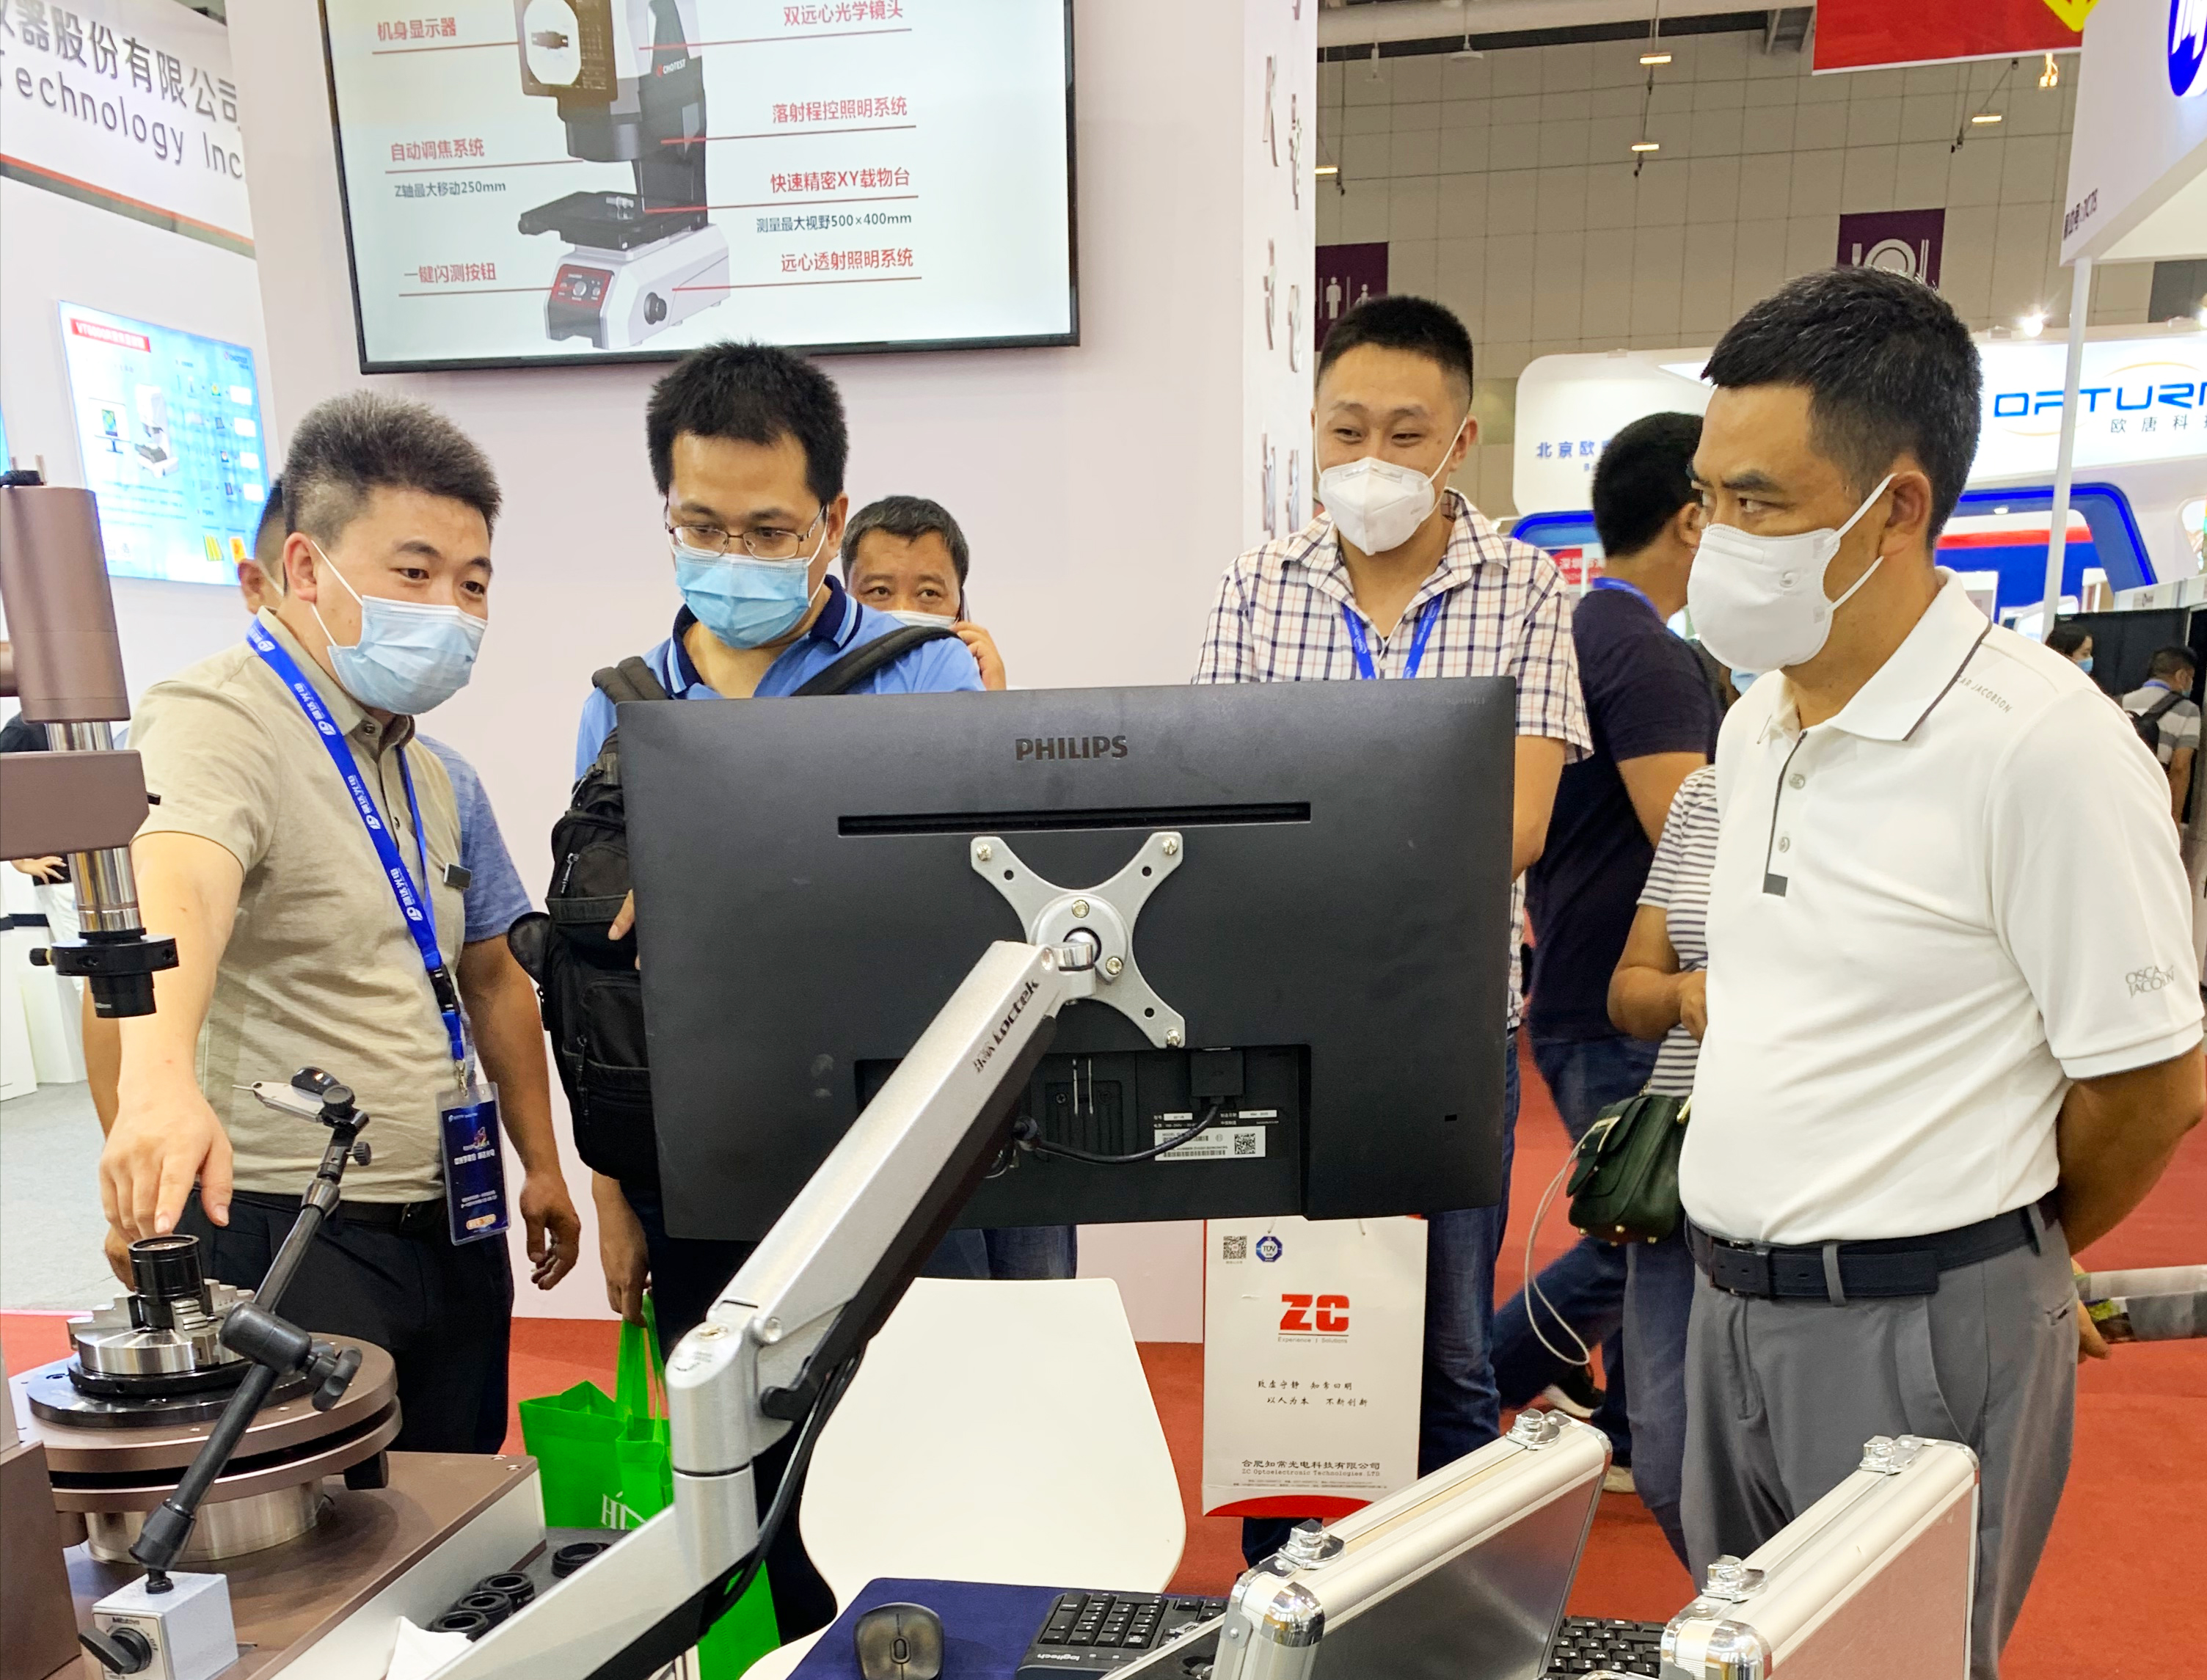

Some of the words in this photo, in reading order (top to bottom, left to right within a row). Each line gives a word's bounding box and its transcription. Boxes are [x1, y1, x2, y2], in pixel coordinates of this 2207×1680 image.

[784, 0, 903, 26] 双远心光学镜头
[377, 16, 457, 41] 机身显示器
[0, 50, 184, 165] echnology
[202, 131, 244, 179] Inc
[773, 96, 908, 123] 落射程控照明系统
[390, 137, 485, 162] 自动调焦系统
[770, 167, 910, 194] 快速精密XY载物台
[781, 248, 913, 272] 远心透射照明系统
[404, 262, 497, 284] 一键闪测按钮
[2110, 414, 2207, 434] 欧唐科
[1536, 440, 1610, 458] 北京欧
[1970, 683, 2013, 713] JACOBSON
[1015, 735, 1128, 761] PHILIPS
[1280, 1293, 1349, 1332] ZC
[1267, 1396, 1309, 1406] 以人为本
[1326, 1397, 1368, 1407] 不断创新
[1241, 1459, 1380, 1470] 合肥知常光电科技有限公司
[1037, 1653, 1080, 1661] logitech
